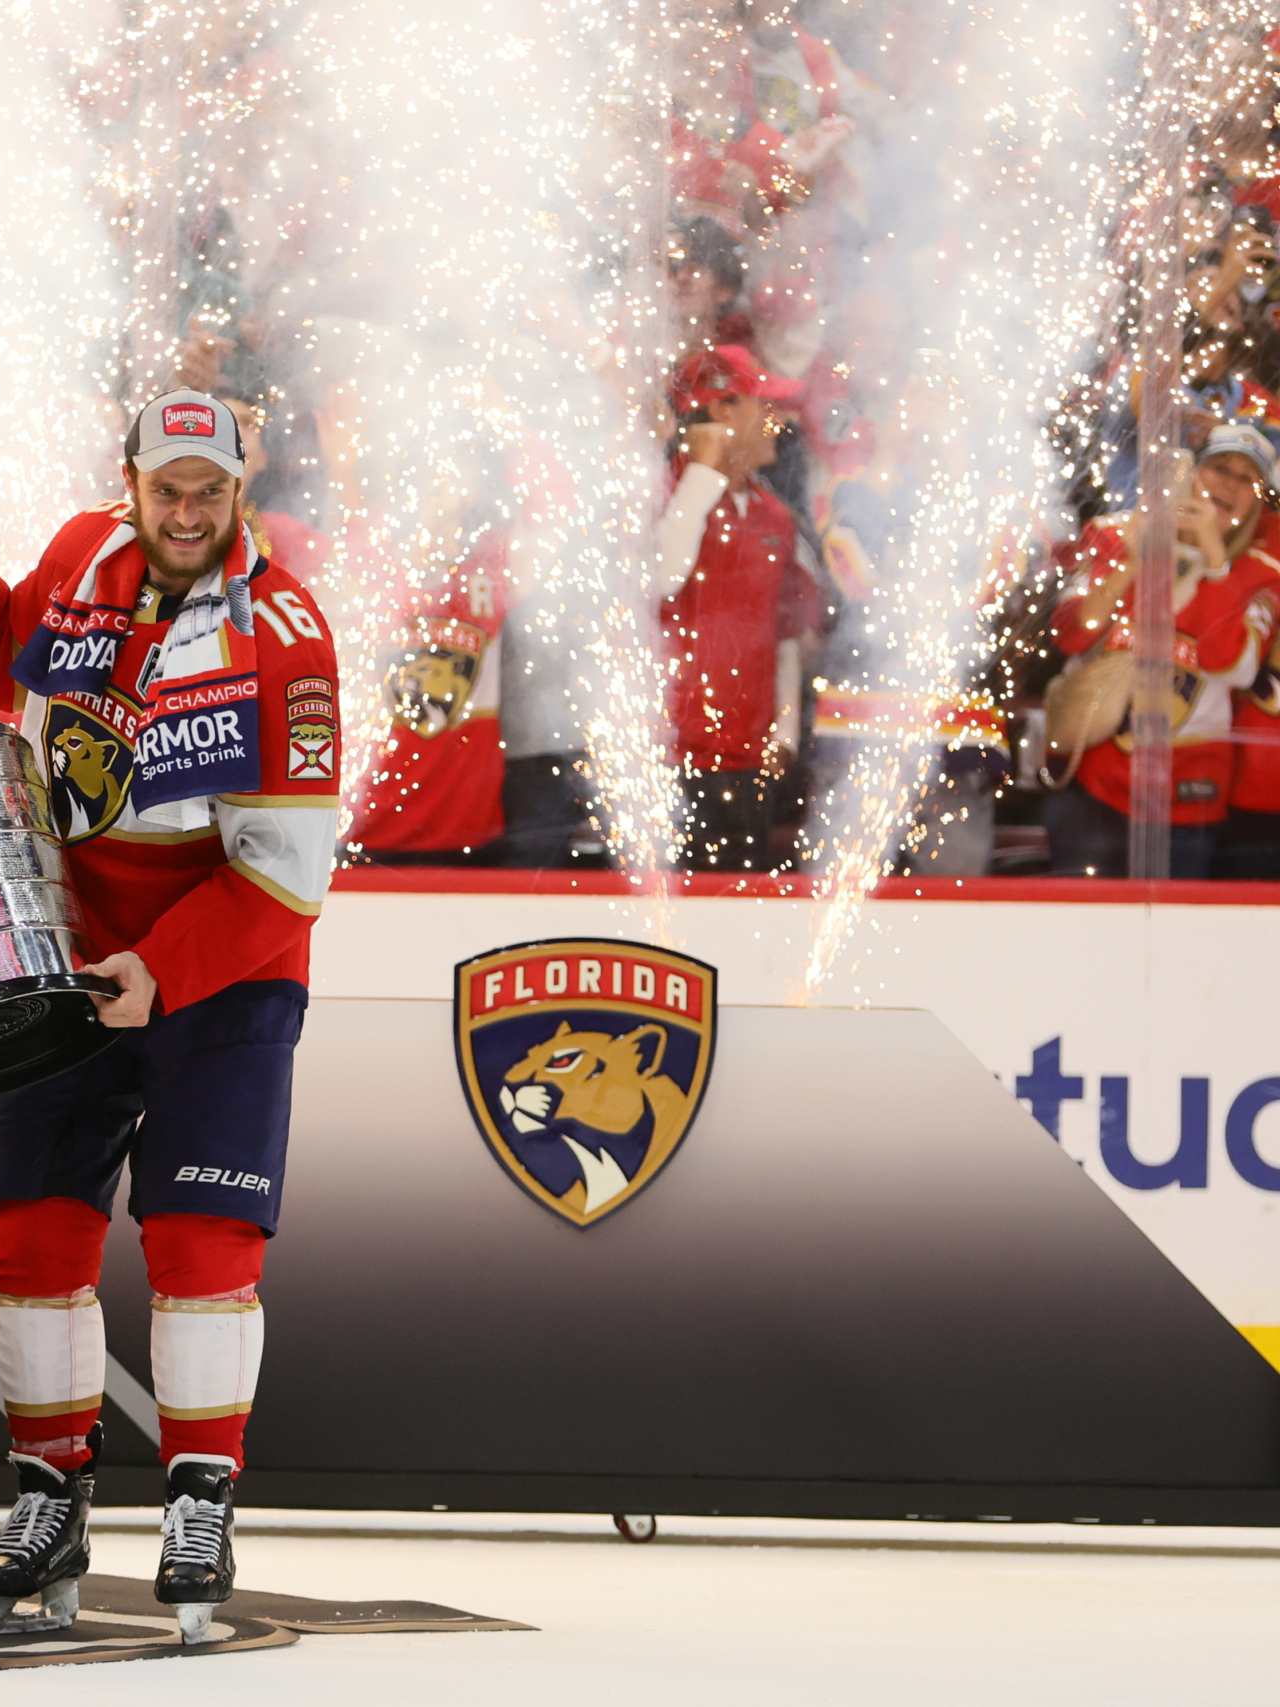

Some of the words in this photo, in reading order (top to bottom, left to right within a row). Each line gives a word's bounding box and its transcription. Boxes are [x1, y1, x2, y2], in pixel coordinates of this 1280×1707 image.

[165, 411, 213, 427] CHAMPIONS
[252, 590, 324, 648] 16
[48, 636, 117, 673] ODYA
[166, 681, 258, 710] CHAMPIO
[293, 681, 327, 694] CAPTAIN
[294, 703, 328, 715] FLORIDA
[142, 757, 192, 780] Sports
[197, 744, 246, 765] Drink
[485, 960, 687, 1011] FLORIDA
[174, 1166, 271, 1196] BAUER
